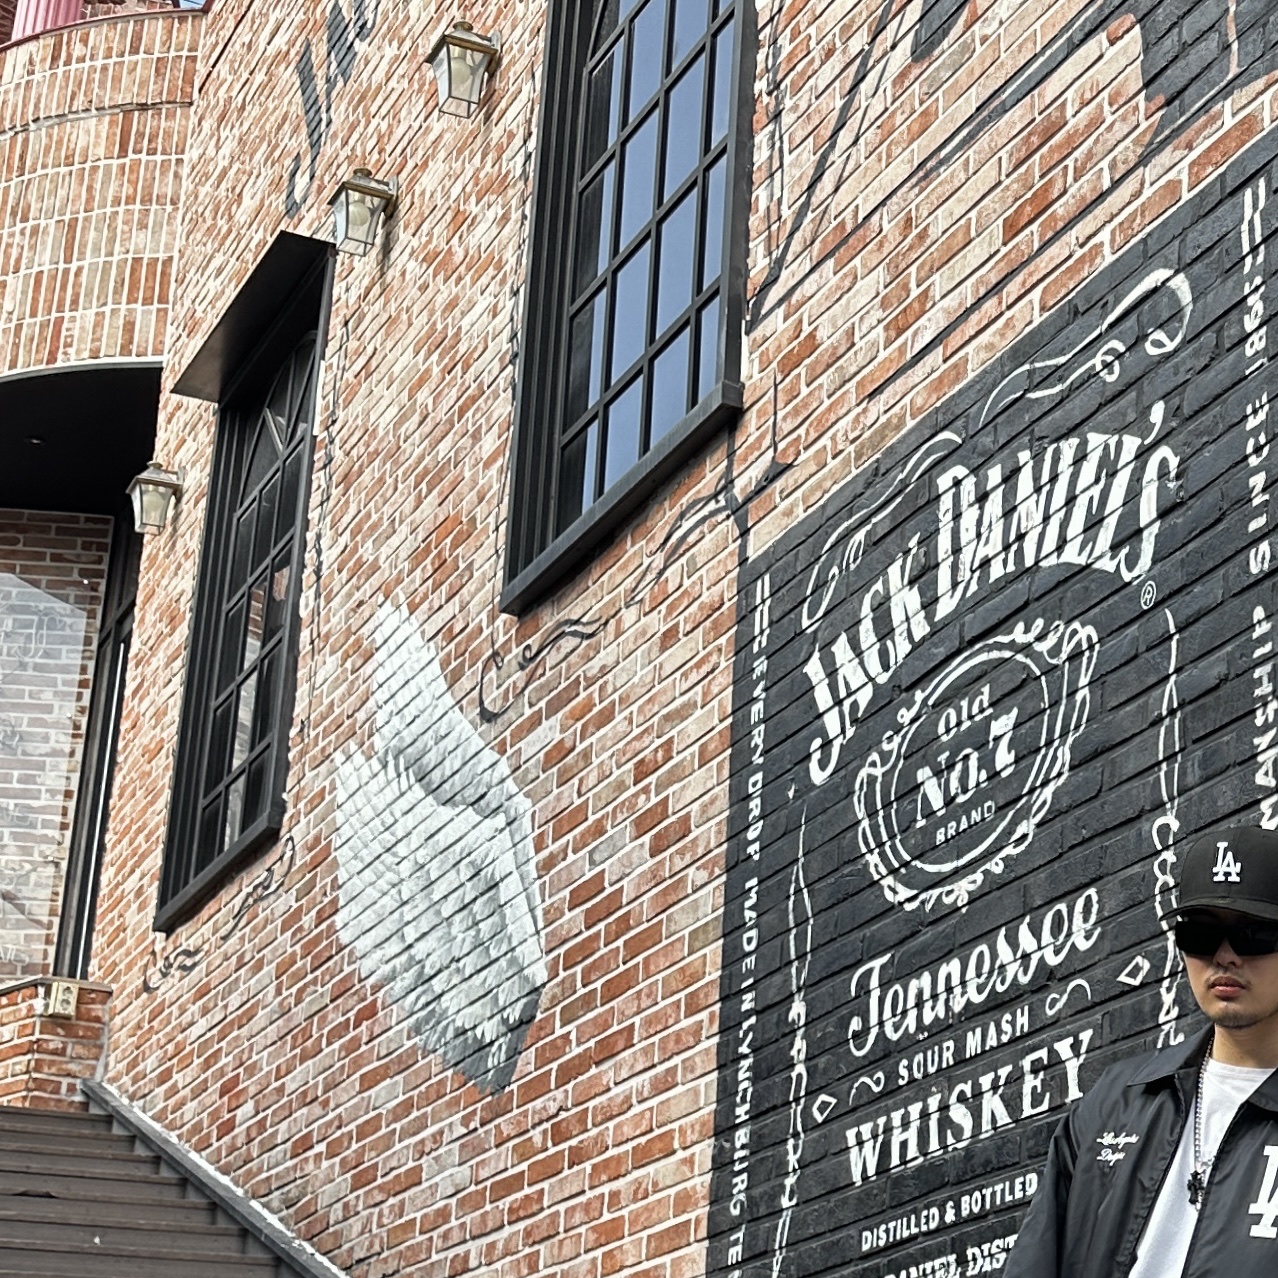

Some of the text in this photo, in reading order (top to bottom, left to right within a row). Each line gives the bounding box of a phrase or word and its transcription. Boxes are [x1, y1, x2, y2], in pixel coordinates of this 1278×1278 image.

[1246, 391, 1271, 575] SINCE
[802, 532, 931, 785] JACK
[934, 400, 1181, 621] DANIEL'S
[749, 655, 769, 764] EVERY
[746, 771, 764, 861] DROP
[935, 799, 996, 846] BRAND
[1211, 841, 1243, 883] LA
[742, 877, 759, 974] MADE
[848, 887, 1102, 1057] Tennessee
[740, 977, 757, 1013] IN
[898, 1005, 1030, 1086] SOUR MASH
[728, 1014, 757, 1217] LYNCHBURG
[845, 1028, 1094, 1187] WHISKEY
[861, 1172, 1039, 1251] DISTILLED & BOTTLED
